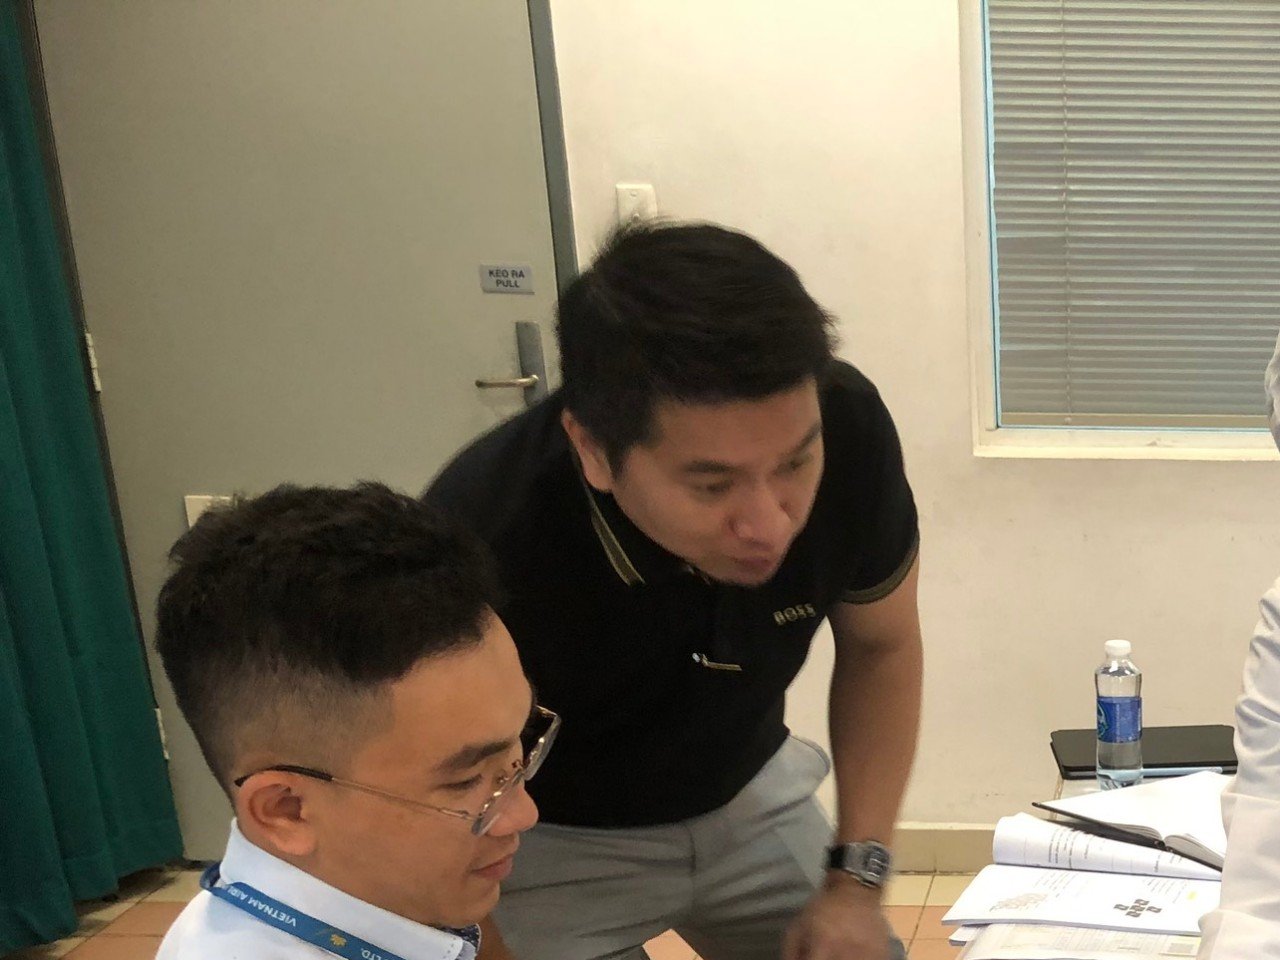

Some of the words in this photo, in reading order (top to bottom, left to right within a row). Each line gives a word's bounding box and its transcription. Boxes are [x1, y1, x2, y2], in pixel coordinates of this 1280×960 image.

[496, 279, 520, 287] PULL
[773, 603, 816, 625] BOSS
[247, 897, 298, 928] VIETNAM
